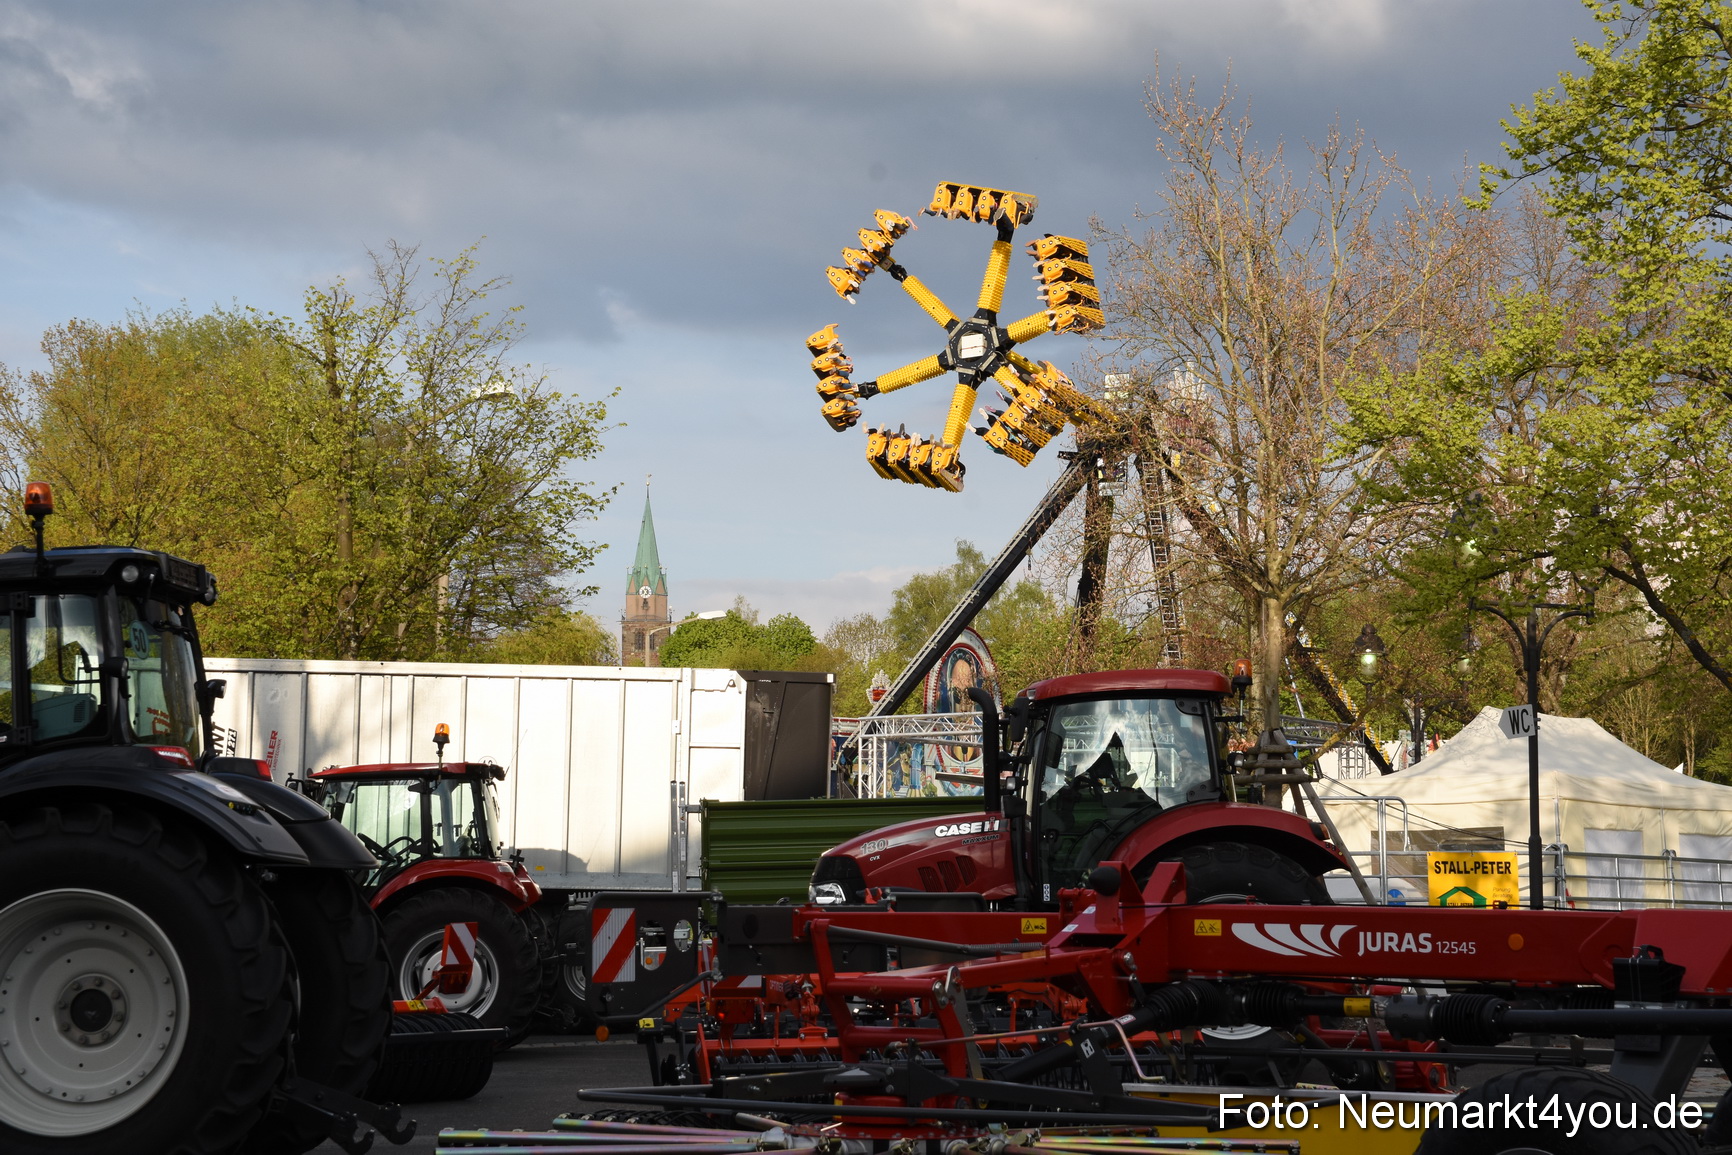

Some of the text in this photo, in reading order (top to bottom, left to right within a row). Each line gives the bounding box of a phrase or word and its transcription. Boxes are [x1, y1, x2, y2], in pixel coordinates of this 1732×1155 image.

[132, 628, 147, 653] 50
[1508, 708, 1530, 735] WC
[211, 721, 226, 756] ANT
[228, 729, 237, 747] 271
[266, 730, 278, 768] EILER
[272, 738, 282, 771] LANDTECHNIK
[934, 821, 983, 838] CASE
[962, 834, 1000, 845] MAXXUM
[861, 839, 888, 855] 130
[1434, 860, 1512, 875] STALL-PETER
[1357, 931, 1477, 957] JURAS 12545
